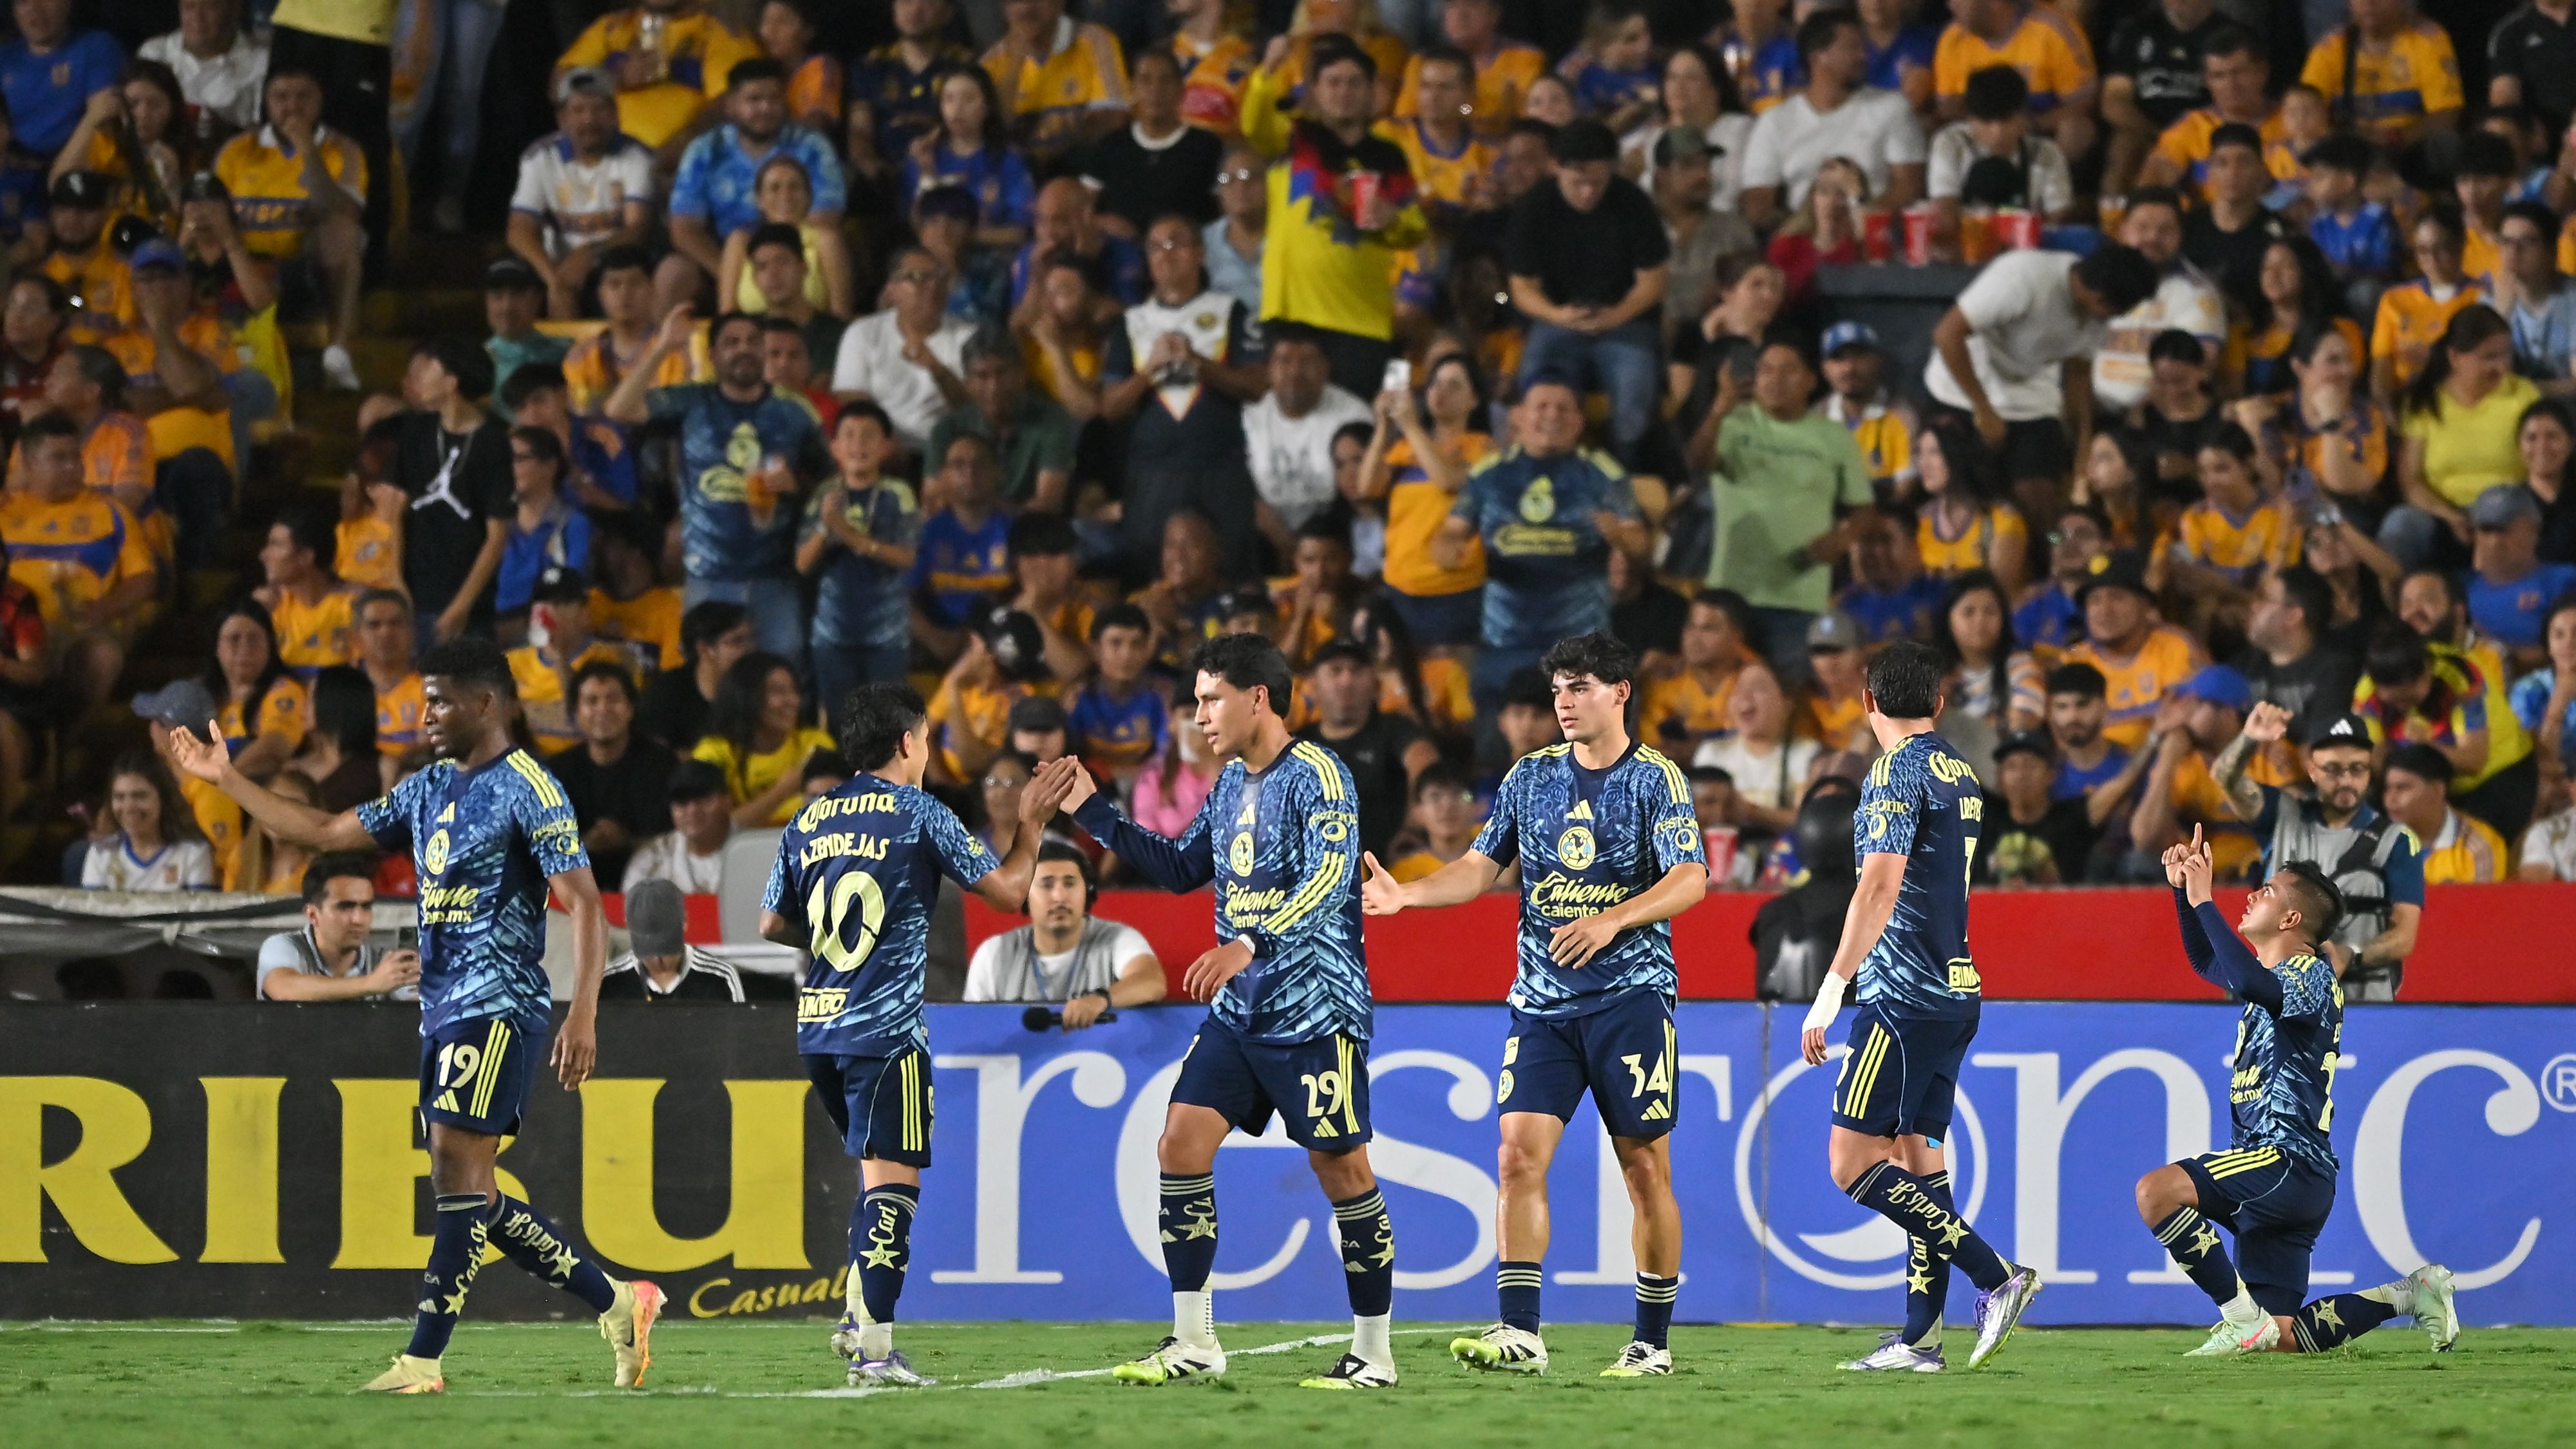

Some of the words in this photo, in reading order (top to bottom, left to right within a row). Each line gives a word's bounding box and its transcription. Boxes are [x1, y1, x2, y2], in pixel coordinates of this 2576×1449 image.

[1530, 870, 1629, 905] Caliente
[806, 871, 886, 972] 10
[439, 1042, 480, 1088] 19
[1621, 1050, 1669, 1098] 34
[1301, 1070, 1343, 1117] 29
[689, 1265, 849, 1318] Casual
